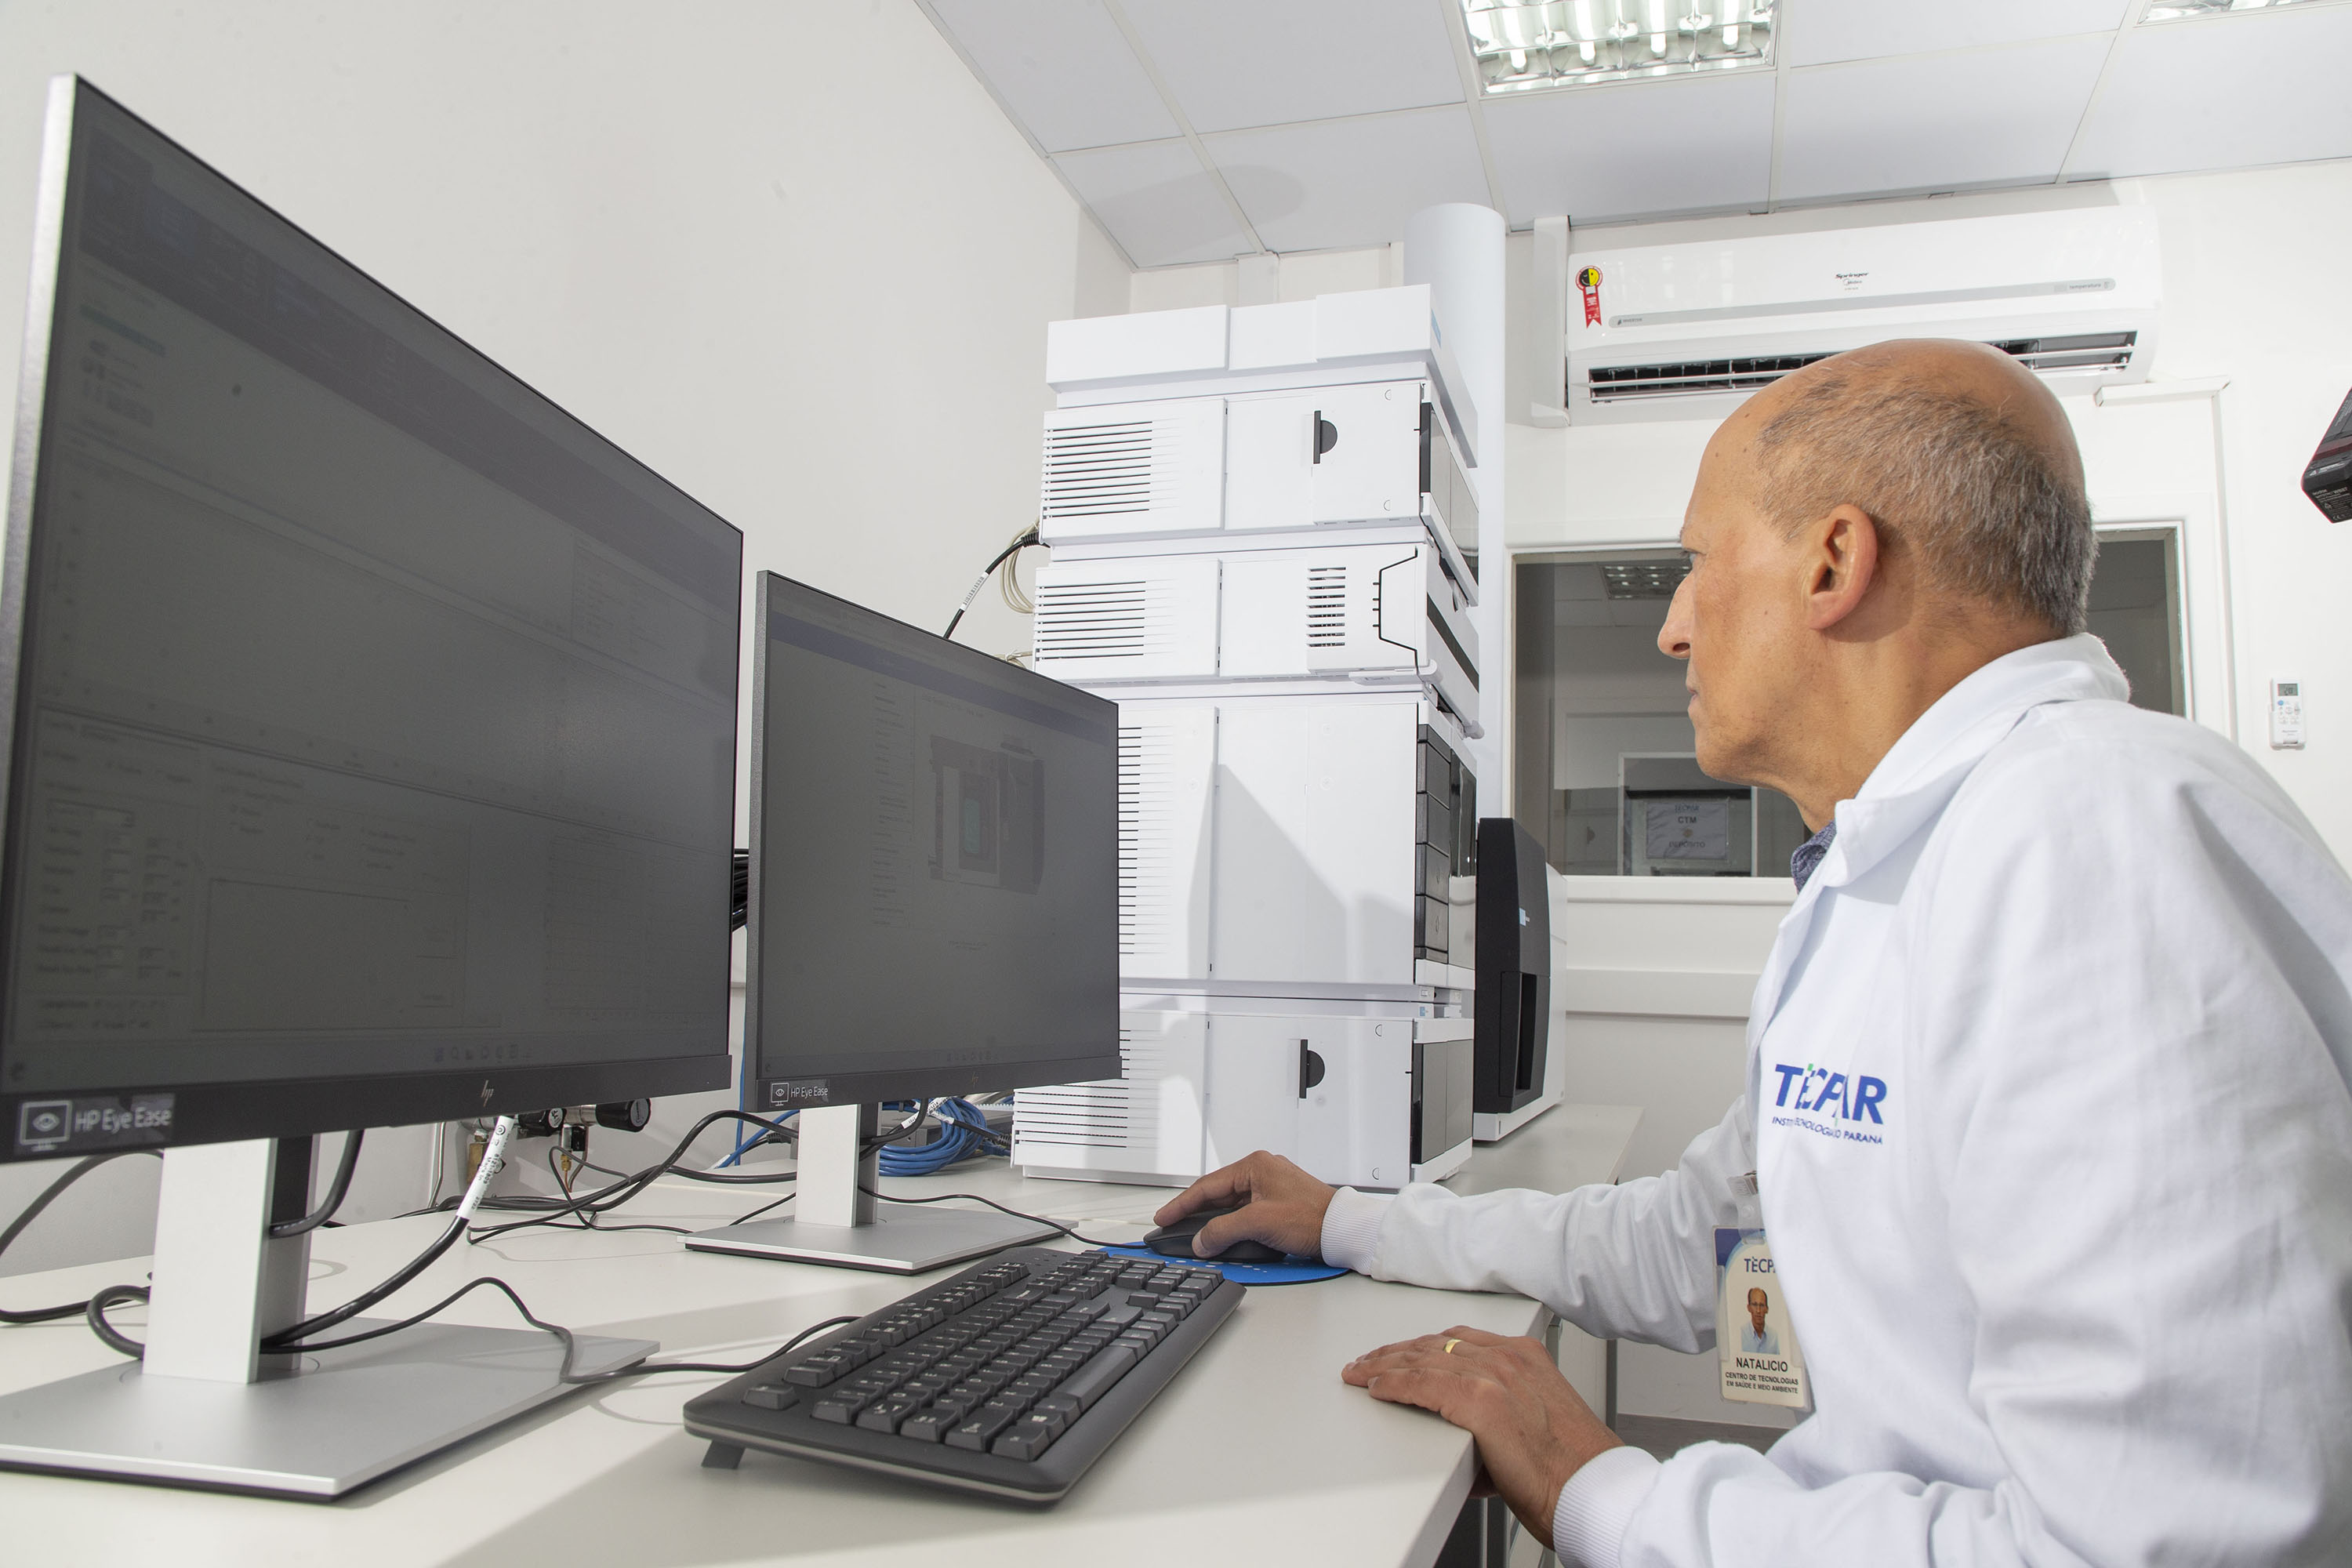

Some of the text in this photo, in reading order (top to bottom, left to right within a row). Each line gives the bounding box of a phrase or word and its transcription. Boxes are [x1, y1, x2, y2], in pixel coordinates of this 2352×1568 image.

[790, 1086, 829, 1099] HP Eye Ease
[74, 1106, 172, 1134] HP Eye Ease
[1744, 1256, 1775, 1273] TÈCP
[1736, 1357, 1788, 1372] NATALICIO
[1726, 1371, 1748, 1380] CENTRO
[1758, 1374, 1798, 1385] TECNOLOGIAS
[1772, 1385, 1798, 1394] AMBIENTE
